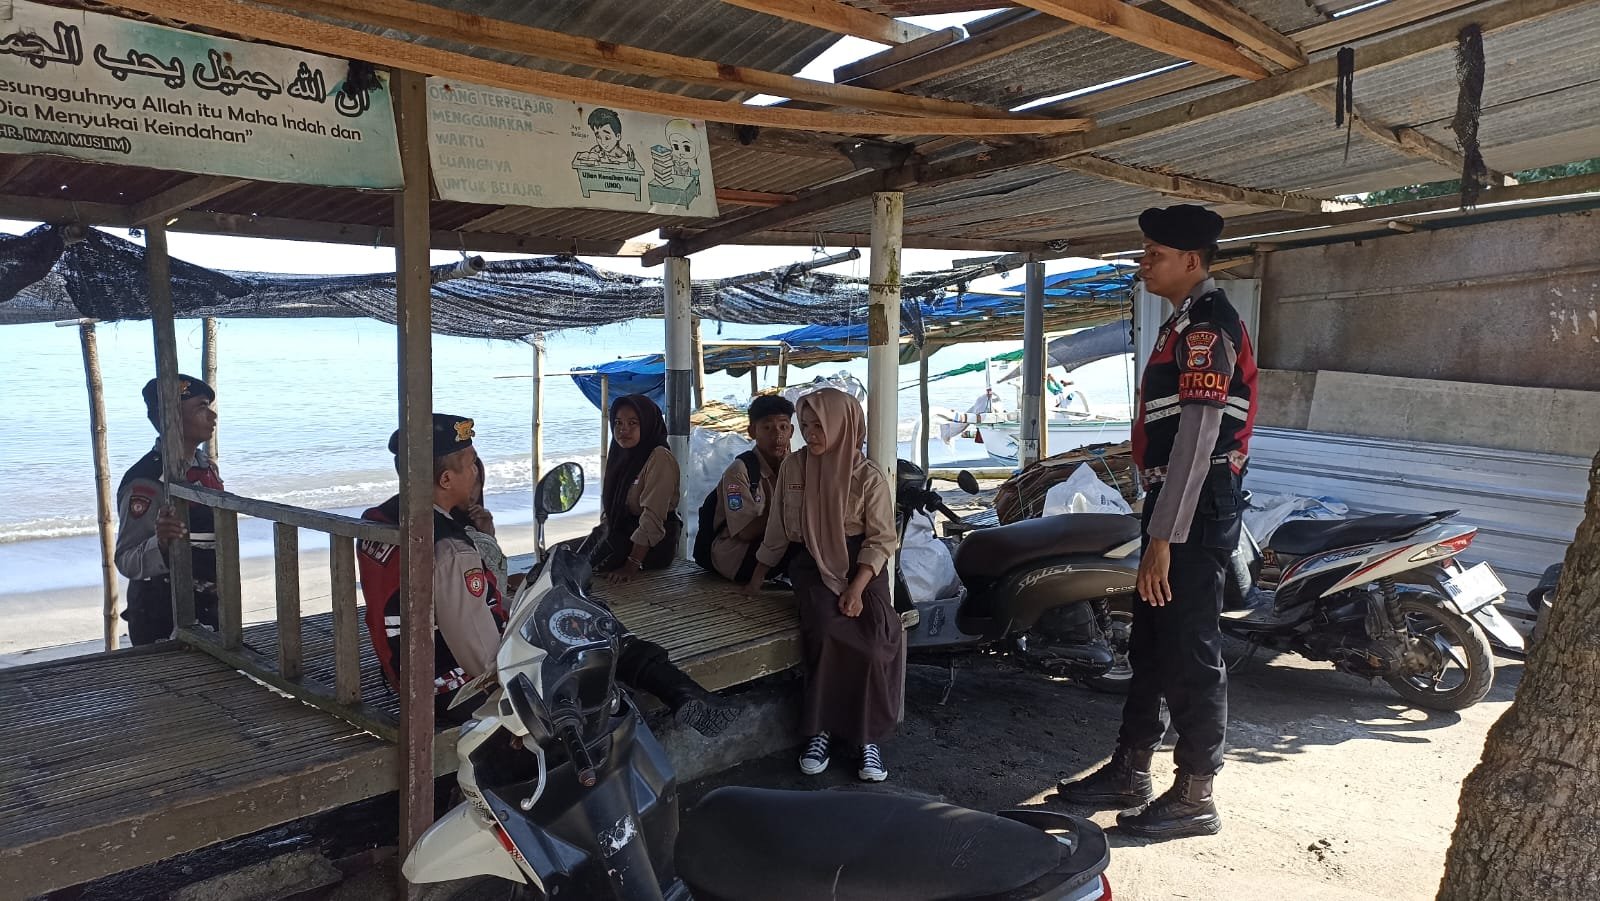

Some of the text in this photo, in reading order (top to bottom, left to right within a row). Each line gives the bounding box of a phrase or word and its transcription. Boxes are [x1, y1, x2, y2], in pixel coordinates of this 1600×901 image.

[94, 43, 185, 89] يحب
[193, 49, 282, 100] جميل
[0, 79, 361, 141] esungguhnya Allah itu Maha Indah dan
[429, 86, 554, 115] ORANG TERPELAJAR
[35, 103, 139, 131] Menyukai
[432, 109, 533, 132] MENGGUNAKAN
[25, 128, 68, 145] IMAM
[69, 133, 131, 153] MUSLIM)
[435, 133, 485, 149] WAKTU
[490, 181, 543, 197] BELAJAR
